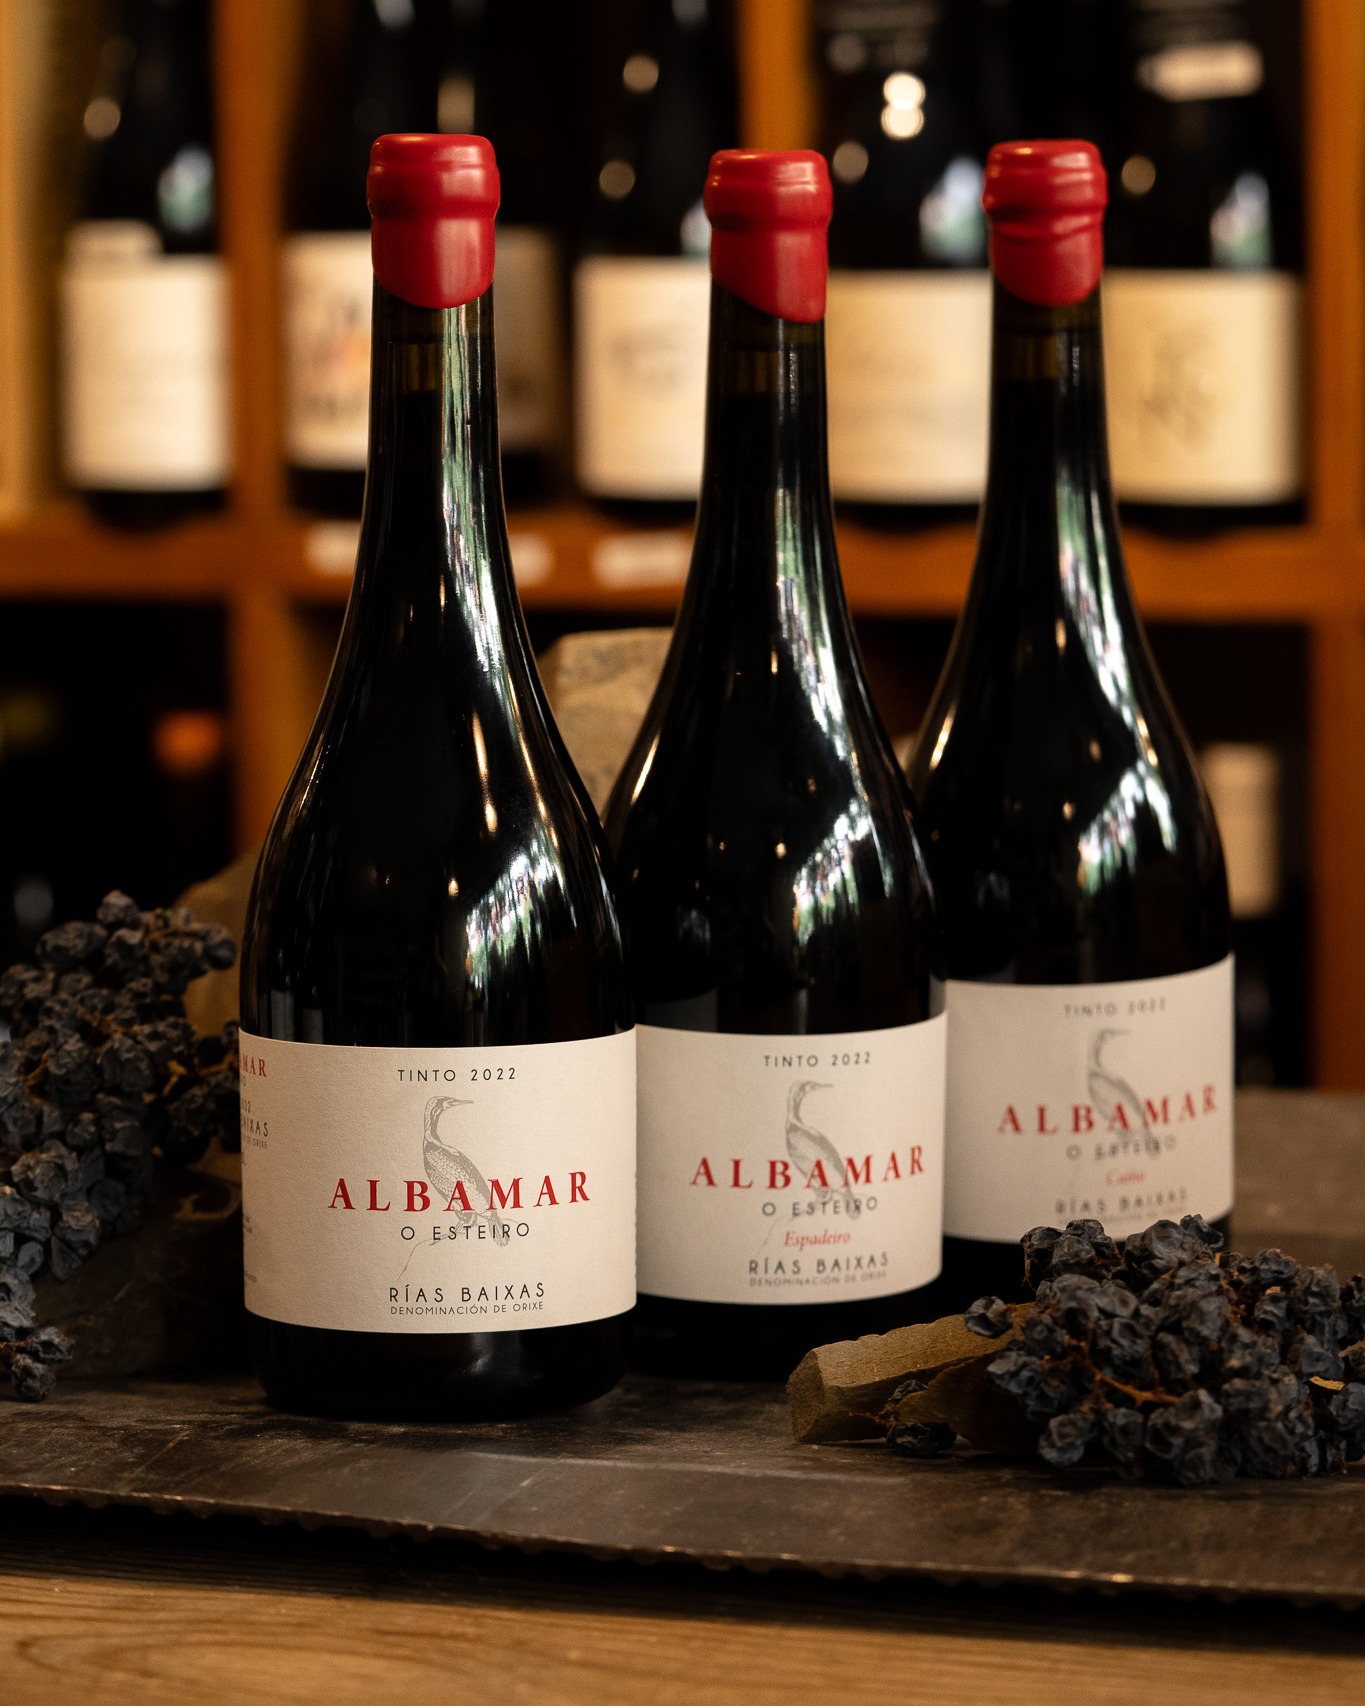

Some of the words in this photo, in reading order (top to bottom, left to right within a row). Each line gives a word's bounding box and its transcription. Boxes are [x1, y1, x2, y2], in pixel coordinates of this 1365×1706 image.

[763, 1055, 819, 1067] TINTO
[831, 1051, 871, 1067] 2022
[397, 1069, 456, 1082] TINTO
[470, 1067, 516, 1081] 2022
[998, 1083, 1217, 1134] ALBAMAR
[690, 1145, 925, 1190] ALBAMAR
[328, 1171, 591, 1212] ALBAMAR
[761, 1202, 777, 1217] O
[792, 1196, 878, 1217] ESTEIRO
[400, 1226, 415, 1240] O
[433, 1222, 530, 1241] ESTEIRO
[784, 1228, 851, 1252] Espadeiro
[749, 1257, 801, 1275] RÍAS
[816, 1251, 889, 1275] BAIXAS
[389, 1284, 444, 1303] RÍAS
[461, 1282, 545, 1303] BAIXAS
[390, 1304, 488, 1316] DENOMINACIÓN
[493, 1304, 507, 1313] DE
[512, 1301, 544, 1312] ORIXE
